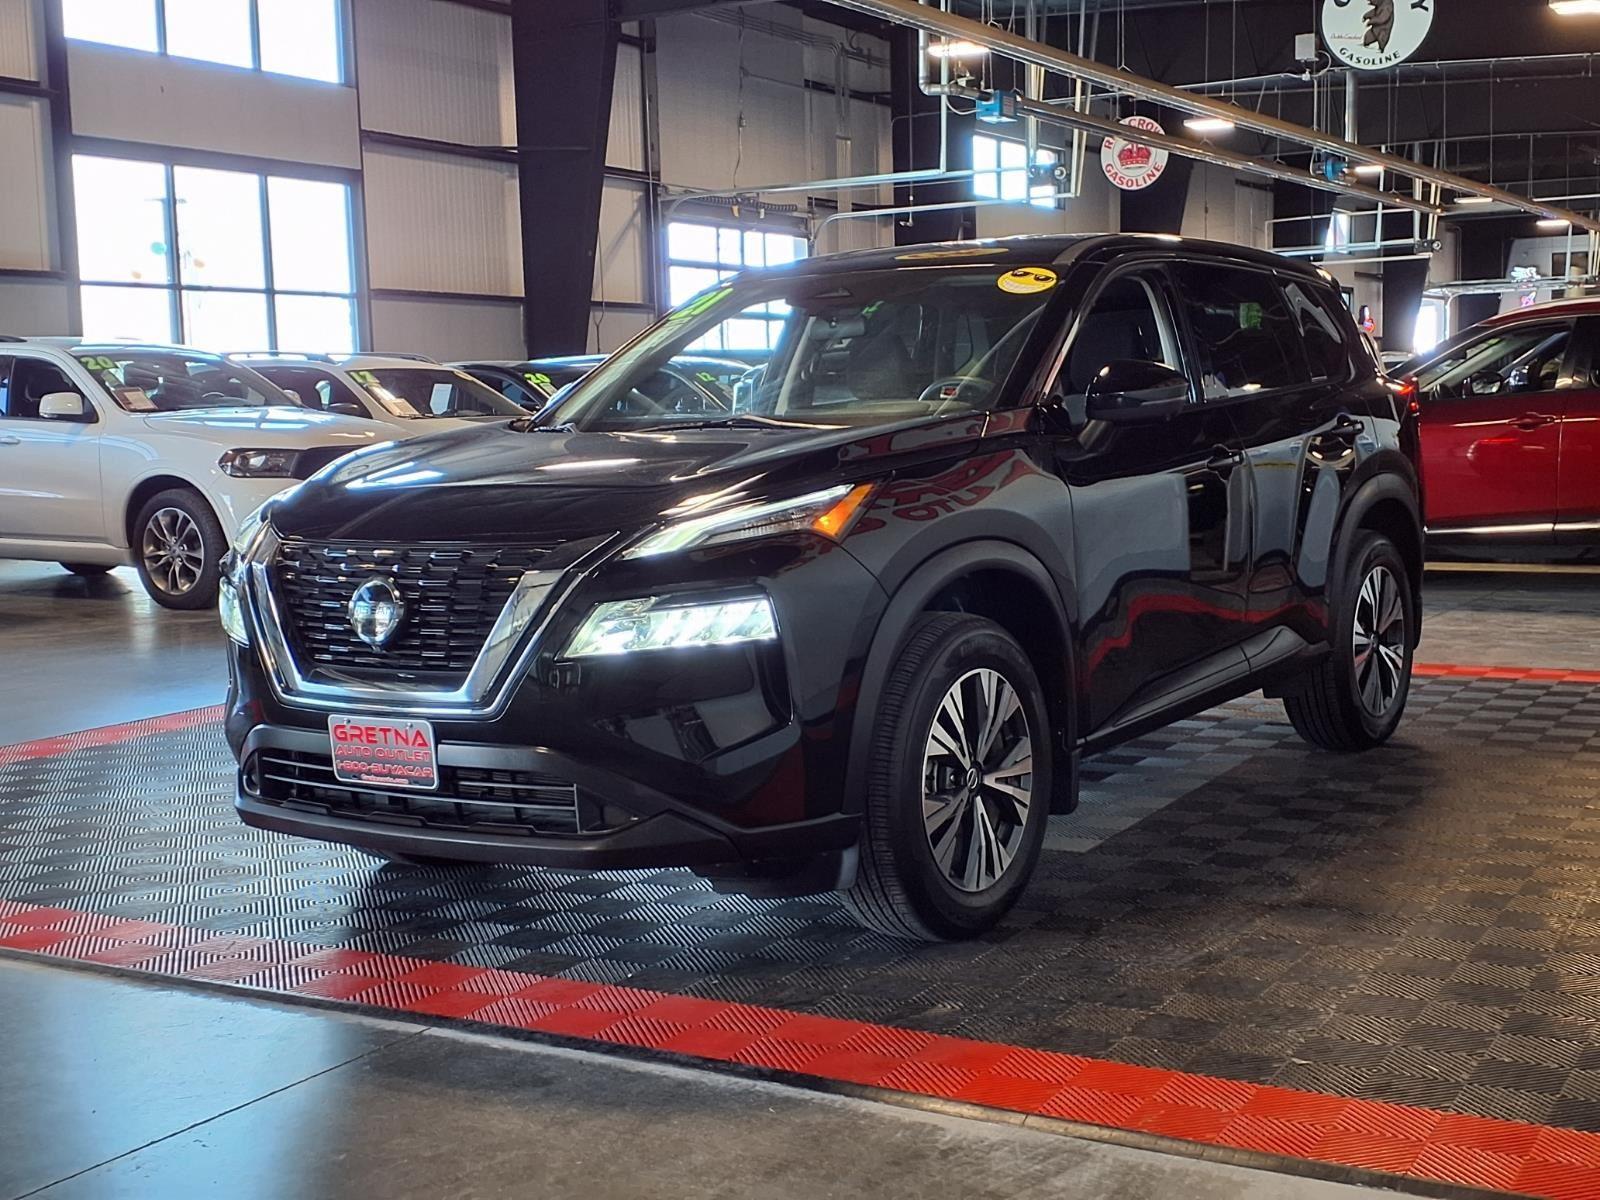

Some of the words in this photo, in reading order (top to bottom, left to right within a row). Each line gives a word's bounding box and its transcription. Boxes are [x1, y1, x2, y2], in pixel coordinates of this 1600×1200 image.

[1340, 47, 1401, 65] GASOLINE
[1104, 162, 1163, 188] GASOLINE
[80, 356, 114, 370] 20
[524, 373, 551, 384] 20
[333, 724, 429, 748] GRETNA
[335, 745, 372, 757] AUTO
[375, 748, 431, 761] OUTLET
